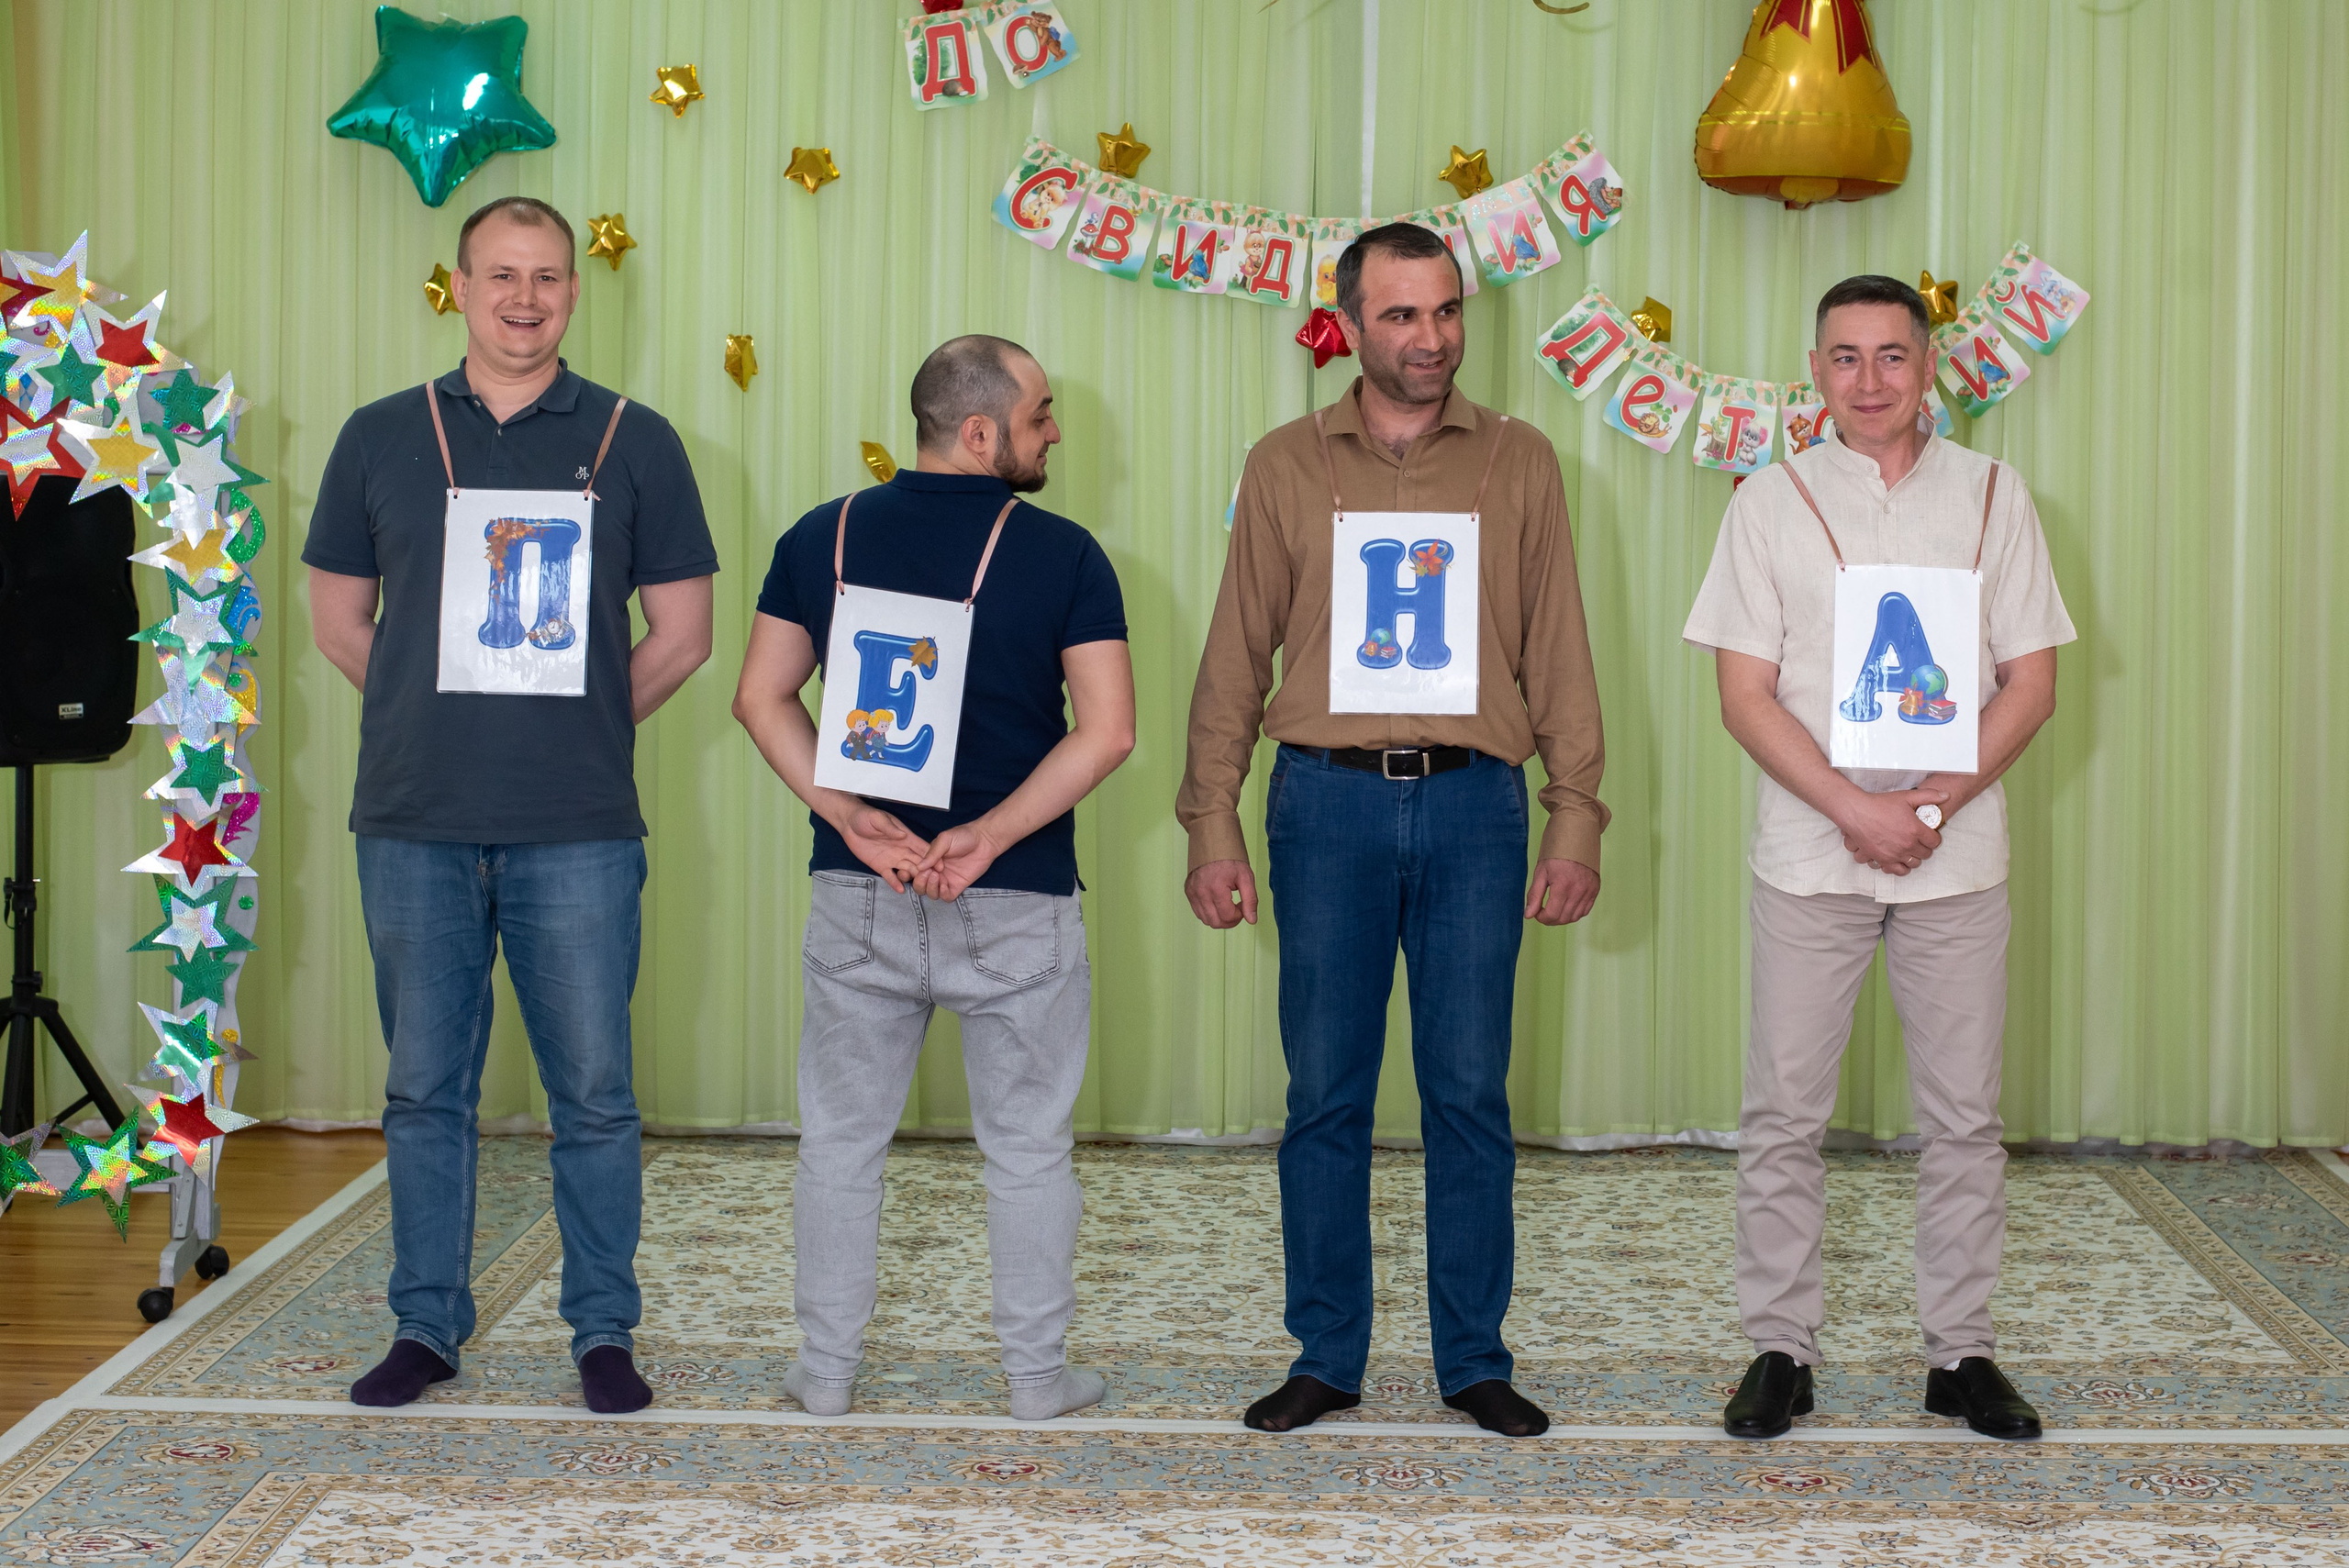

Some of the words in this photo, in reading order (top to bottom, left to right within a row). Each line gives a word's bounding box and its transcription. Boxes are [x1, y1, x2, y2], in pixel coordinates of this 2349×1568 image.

[478, 517, 581, 650] П
[1357, 539, 1453, 670] Н
[841, 630, 938, 772] Е
[1840, 592, 1955, 725] А
